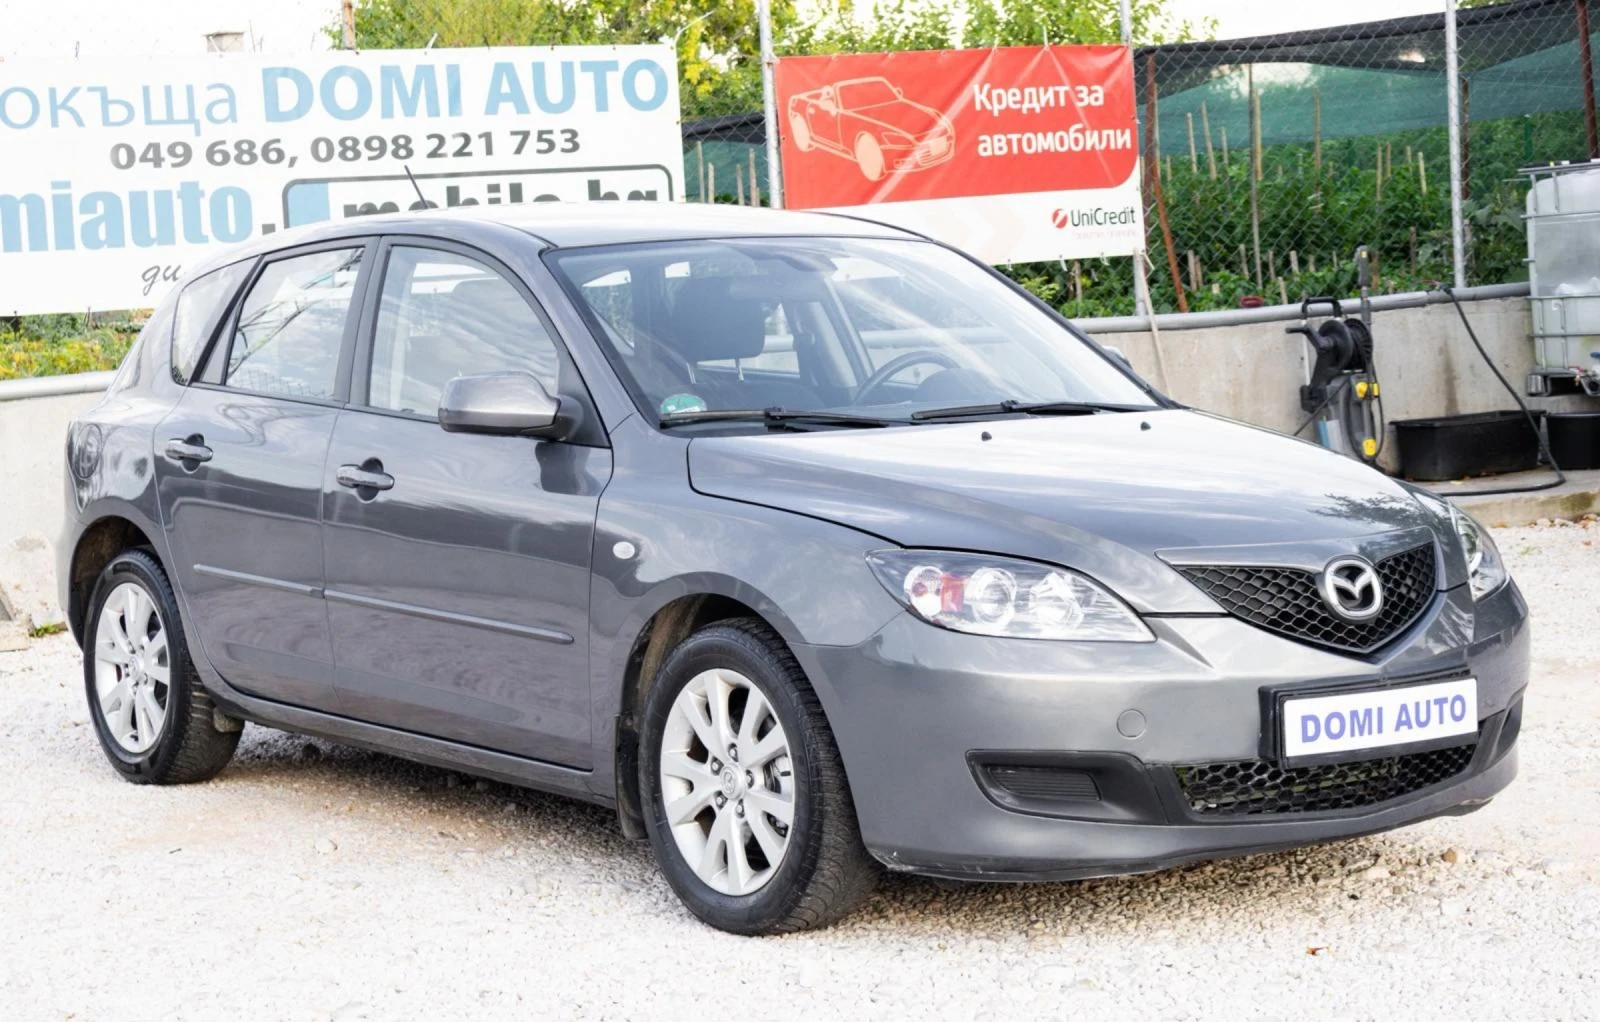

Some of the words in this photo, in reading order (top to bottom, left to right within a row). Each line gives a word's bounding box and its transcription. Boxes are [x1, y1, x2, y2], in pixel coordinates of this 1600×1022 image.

[262, 64, 463, 123] DOMI
[484, 59, 669, 116] AUTO
[973, 83, 1070, 117] Кредит
[1075, 84, 1104, 107] за
[110, 141, 193, 170] 049
[205, 138, 298, 169] 686,
[310, 134, 414, 163] 0898
[426, 131, 494, 159] 221
[510, 128, 581, 155] 753
[977, 123, 1132, 157] автомобили
[1071, 207, 1136, 227] UniCredit
[1301, 706, 1383, 743] DOMI
[1394, 694, 1466, 732] AUTO
